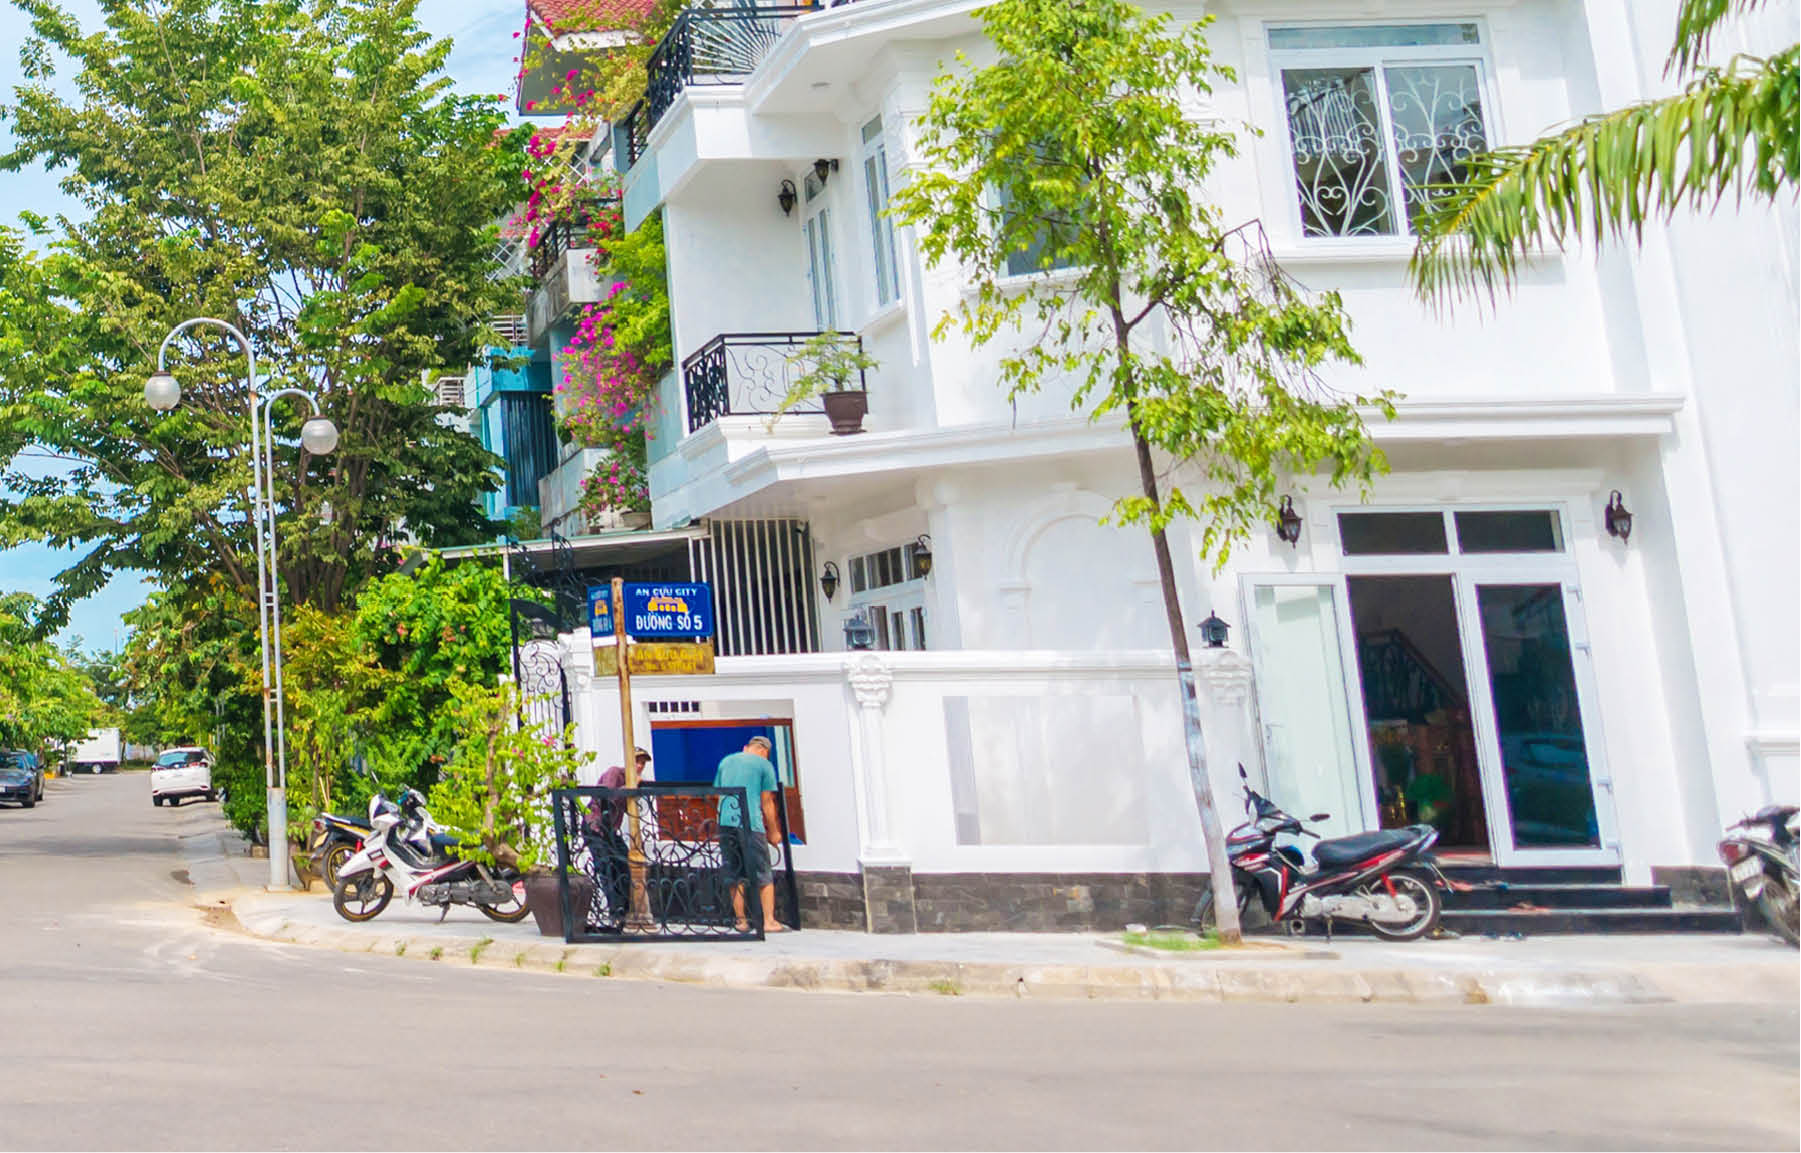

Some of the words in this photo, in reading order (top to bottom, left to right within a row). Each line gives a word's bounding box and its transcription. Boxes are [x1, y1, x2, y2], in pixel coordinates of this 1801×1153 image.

[635, 588, 650, 597] AN
[675, 588, 698, 597] CITY
[693, 614, 703, 631] 5
